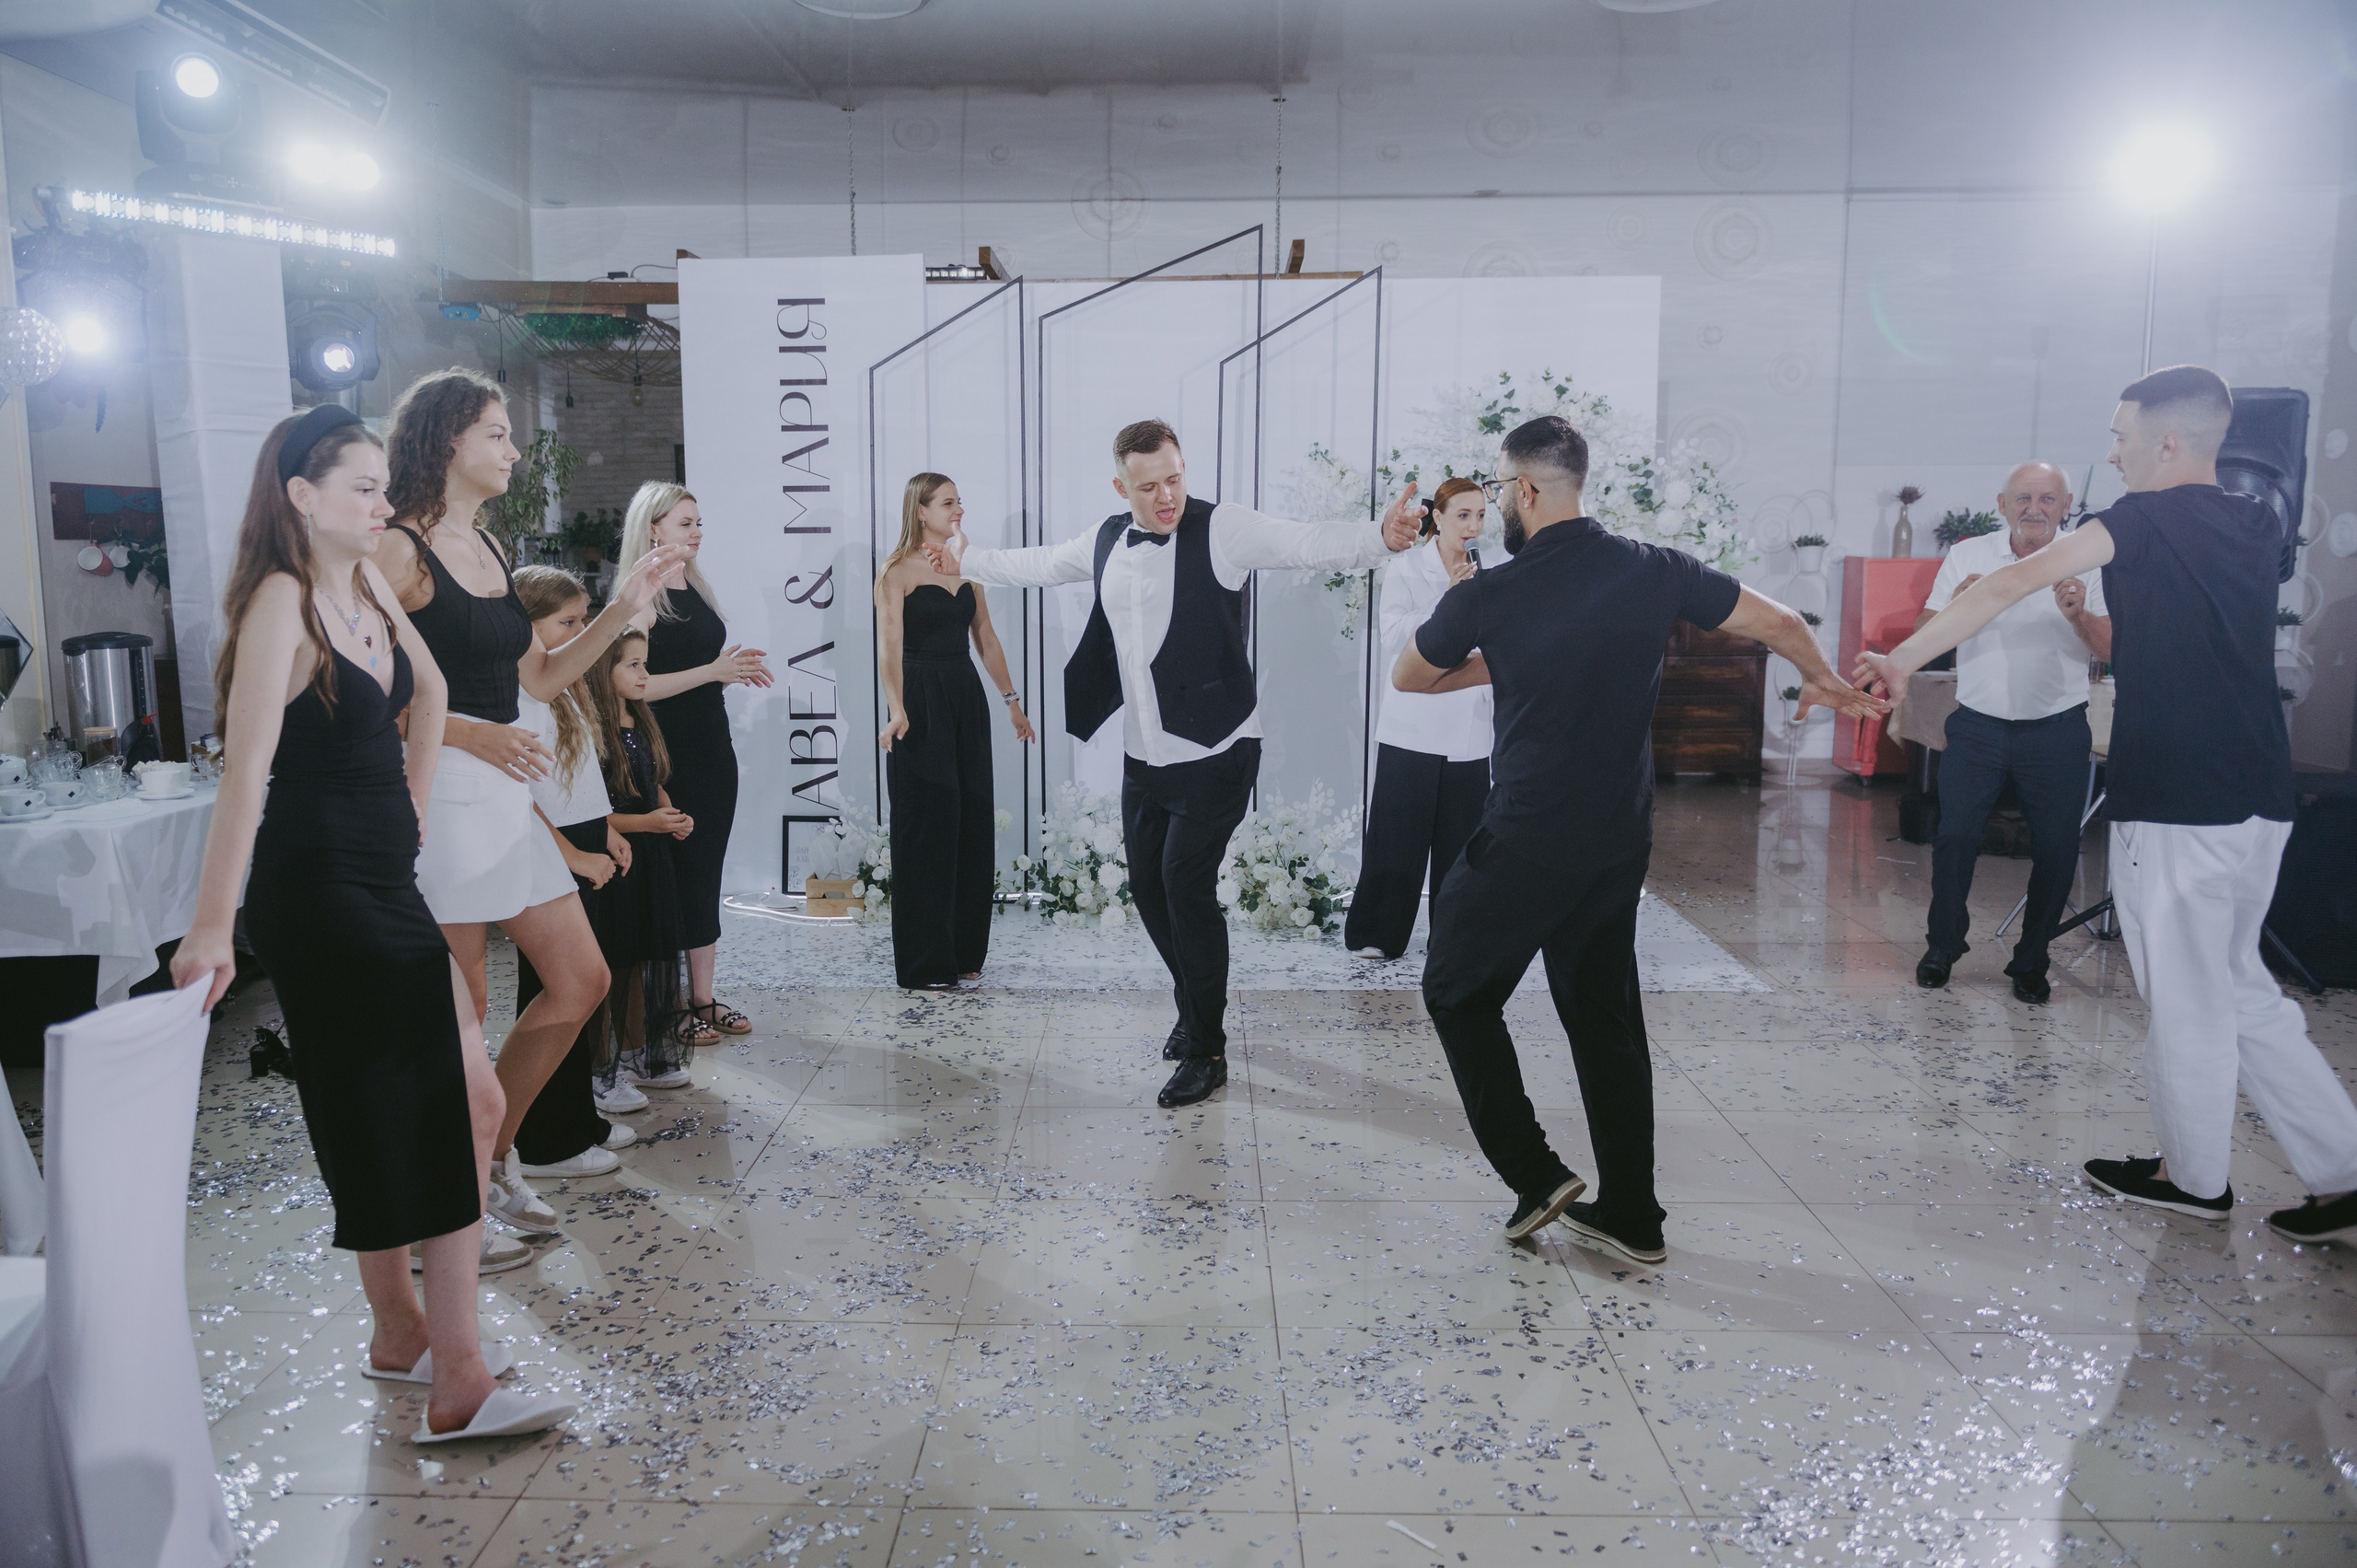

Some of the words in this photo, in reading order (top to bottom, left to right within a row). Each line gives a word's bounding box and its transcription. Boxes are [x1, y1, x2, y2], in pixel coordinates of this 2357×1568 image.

[777, 298, 831, 534] МАРИЯ
[784, 564, 834, 610] &
[788, 641, 839, 810] АВЕЛ
